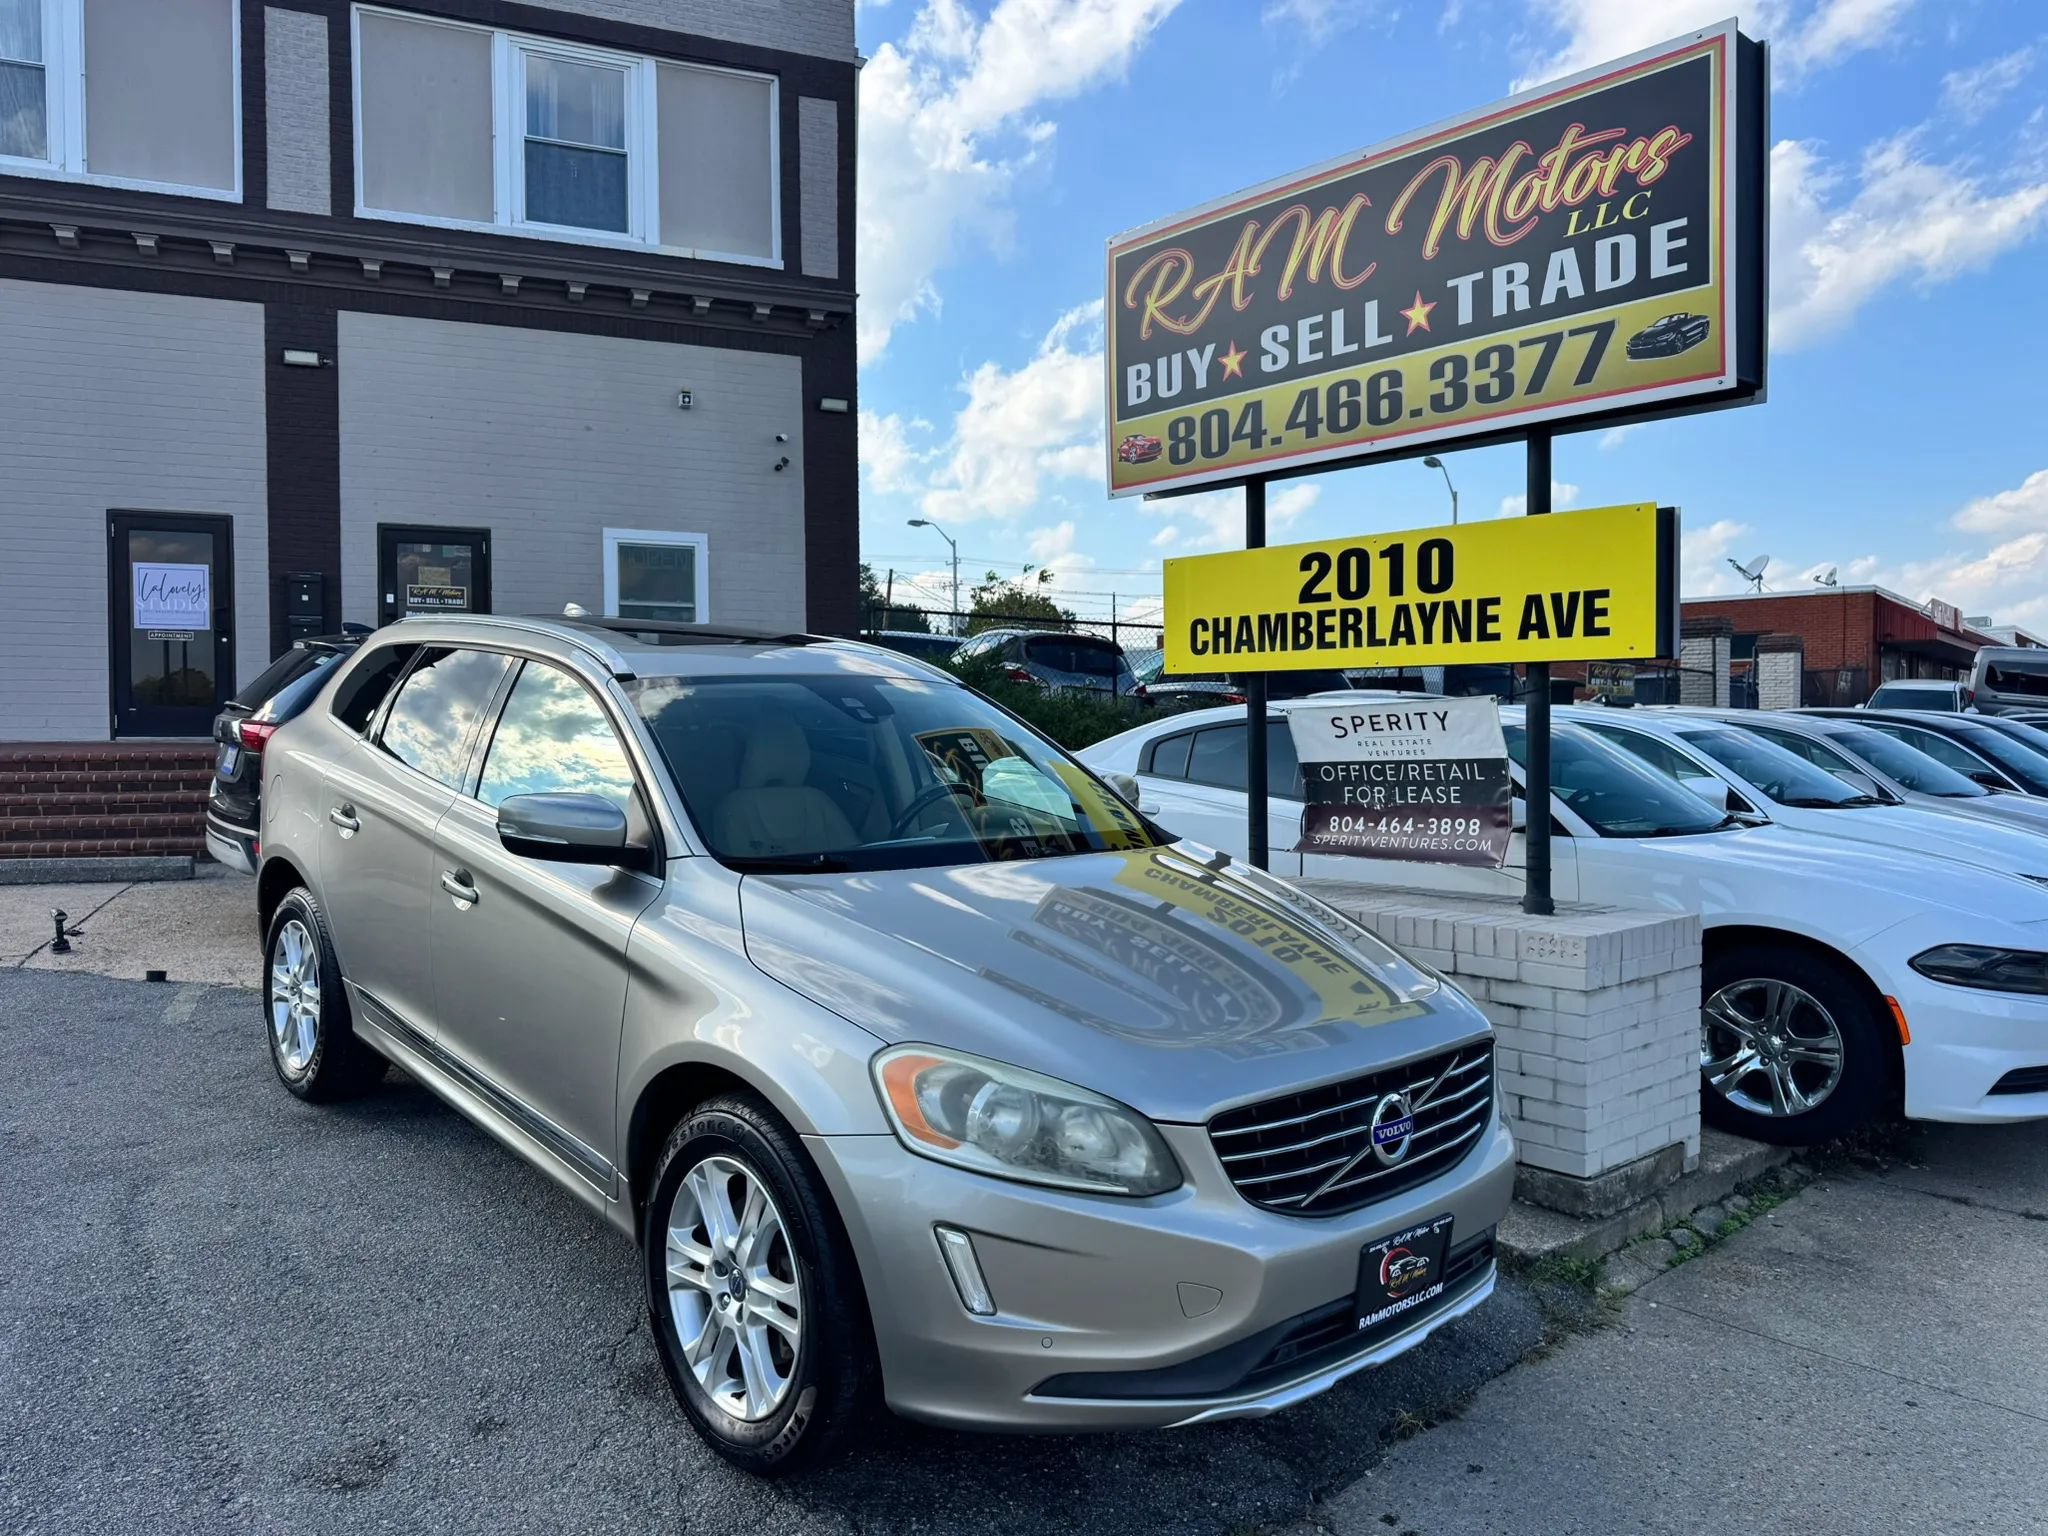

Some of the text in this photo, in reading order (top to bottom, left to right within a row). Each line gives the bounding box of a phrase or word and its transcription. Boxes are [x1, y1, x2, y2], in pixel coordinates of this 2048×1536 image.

[1563, 190, 1652, 238] LLC
[1124, 136, 1693, 340] RAM Motors
[1127, 217, 1688, 407] BUY SELL TRADE
[1168, 320, 1616, 467] 804.466.3377
[1299, 538, 1455, 604] 2010
[1190, 588, 1611, 656] CHAMBERLAYNE AVE
[1331, 710, 1449, 739] SPERITY
[1357, 738, 1432, 747] REAL ESTATE
[1367, 748, 1427, 757] VENTURES
[1320, 763, 1486, 782] OFFICE/RETAIL
[1344, 786, 1462, 804] FOR LEASE
[1329, 816, 1481, 836] 804-464-3898
[1313, 834, 1492, 851] SPERITYVENTURES.COM
[1376, 1120, 1411, 1139] VOLVO
